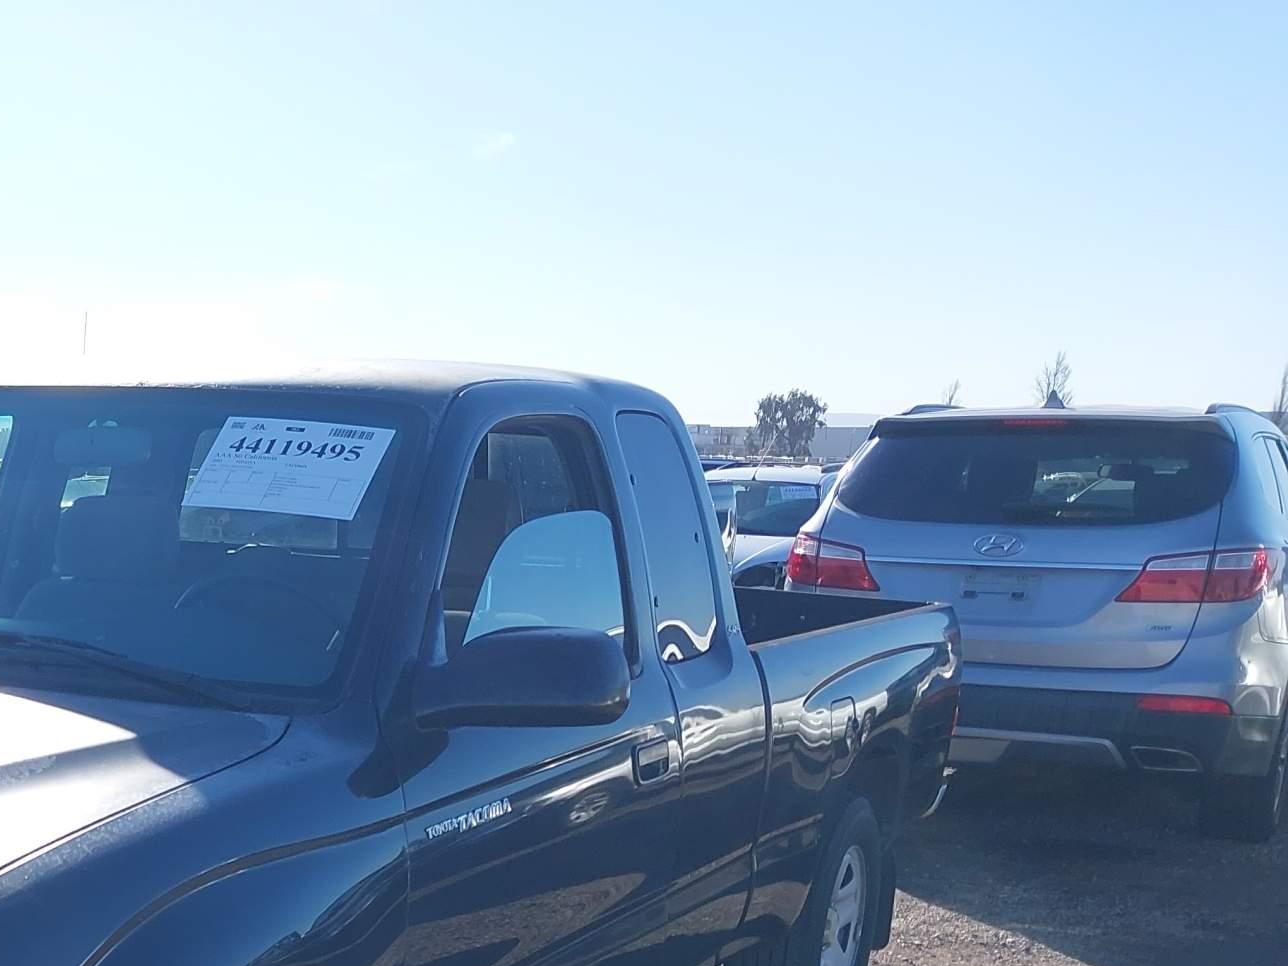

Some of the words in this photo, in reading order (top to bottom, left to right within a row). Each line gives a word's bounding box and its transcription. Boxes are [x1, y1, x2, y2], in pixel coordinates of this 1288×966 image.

[229, 436, 365, 462] 44119495
[425, 819, 459, 840] TOYOTA
[457, 797, 513, 833] TACOMA
